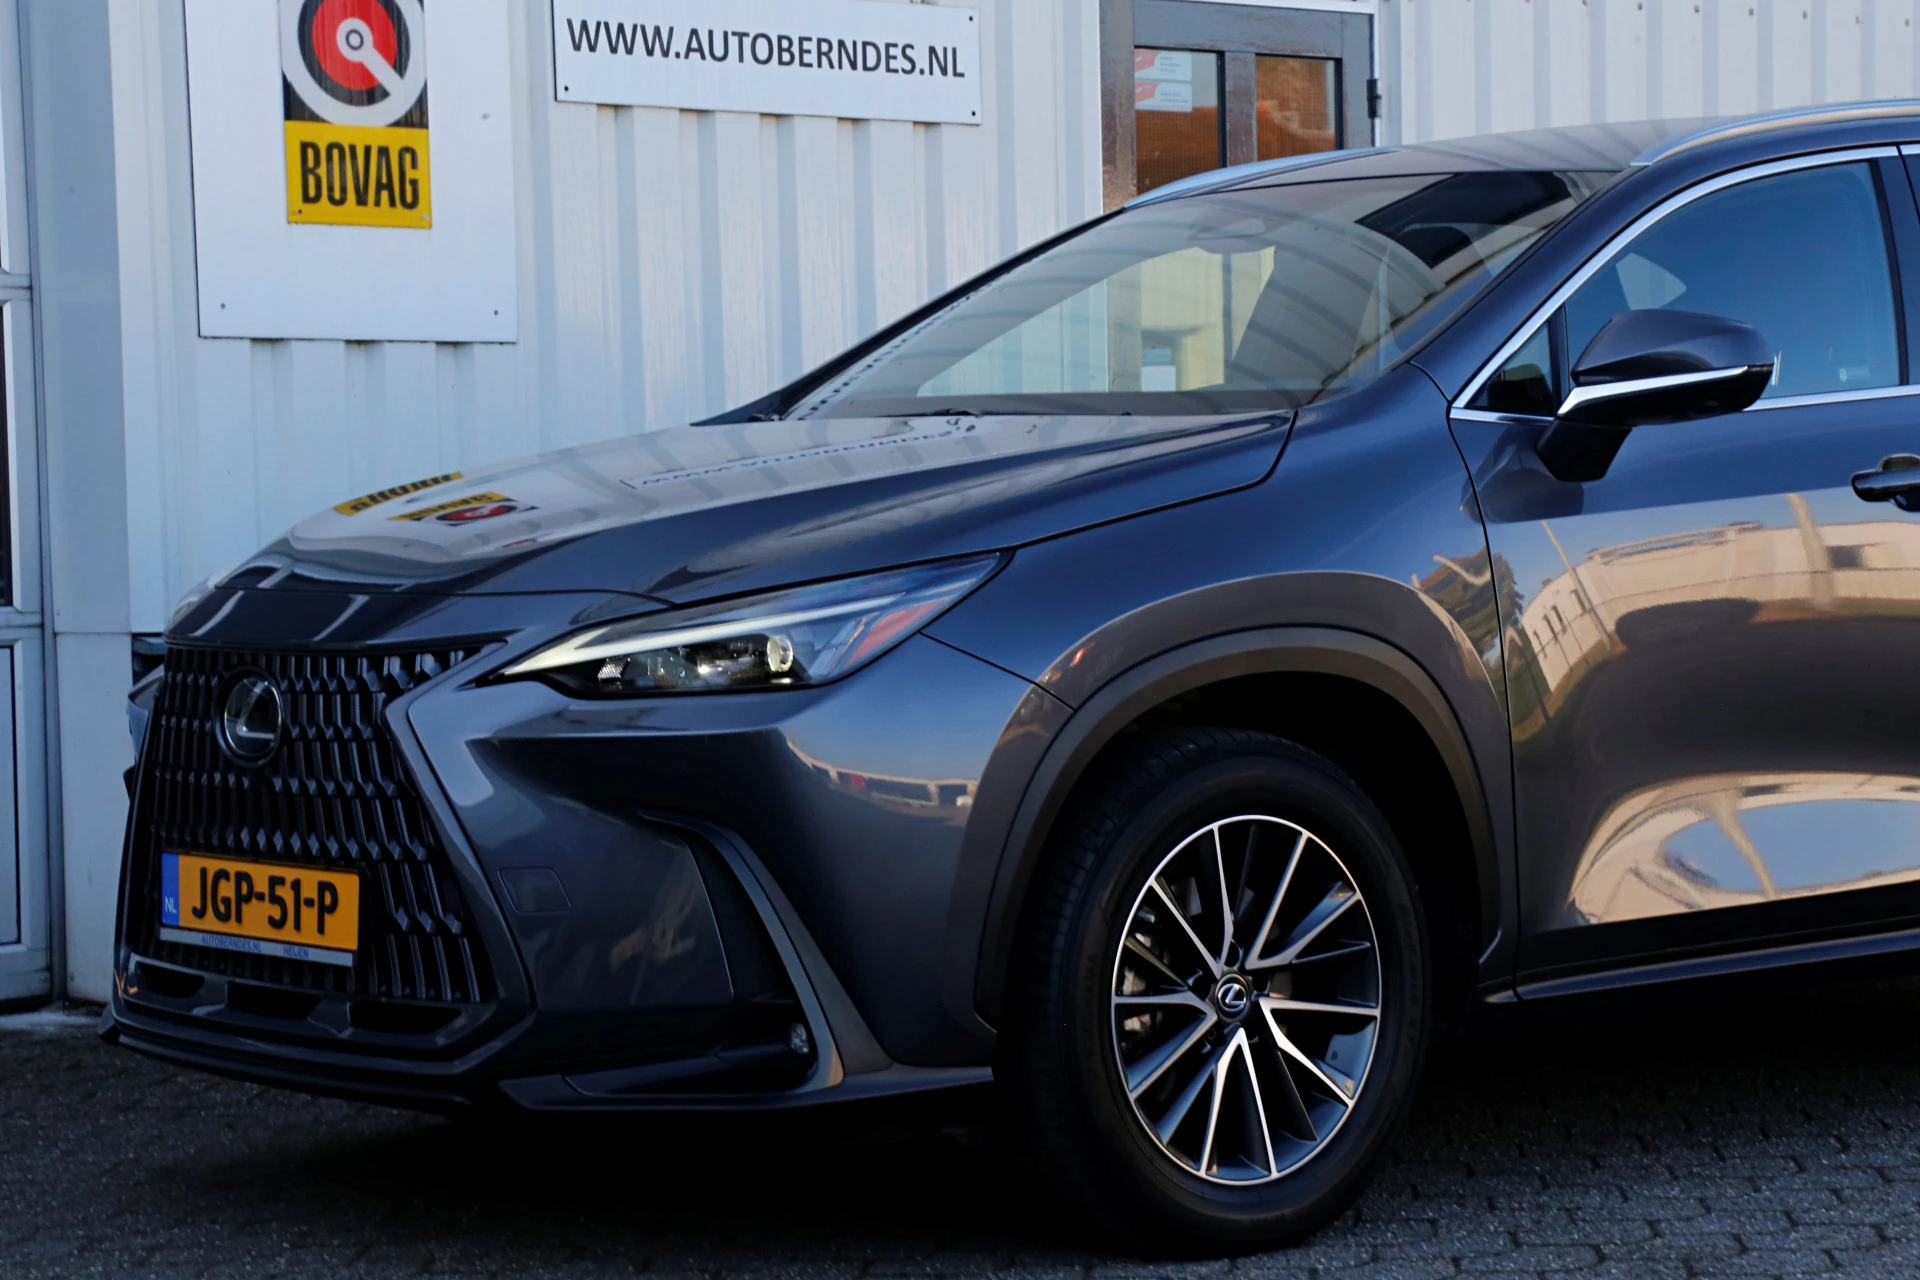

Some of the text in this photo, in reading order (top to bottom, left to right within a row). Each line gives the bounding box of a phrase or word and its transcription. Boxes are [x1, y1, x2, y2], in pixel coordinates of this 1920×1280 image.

[566, 17, 966, 79] WWW.AUTOBERNDES.NL
[299, 140, 420, 210] BOVAG
[164, 896, 177, 914] NL
[191, 866, 338, 935] JGP-51-P
[201, 934, 262, 953] AUTOBERNDES.NL
